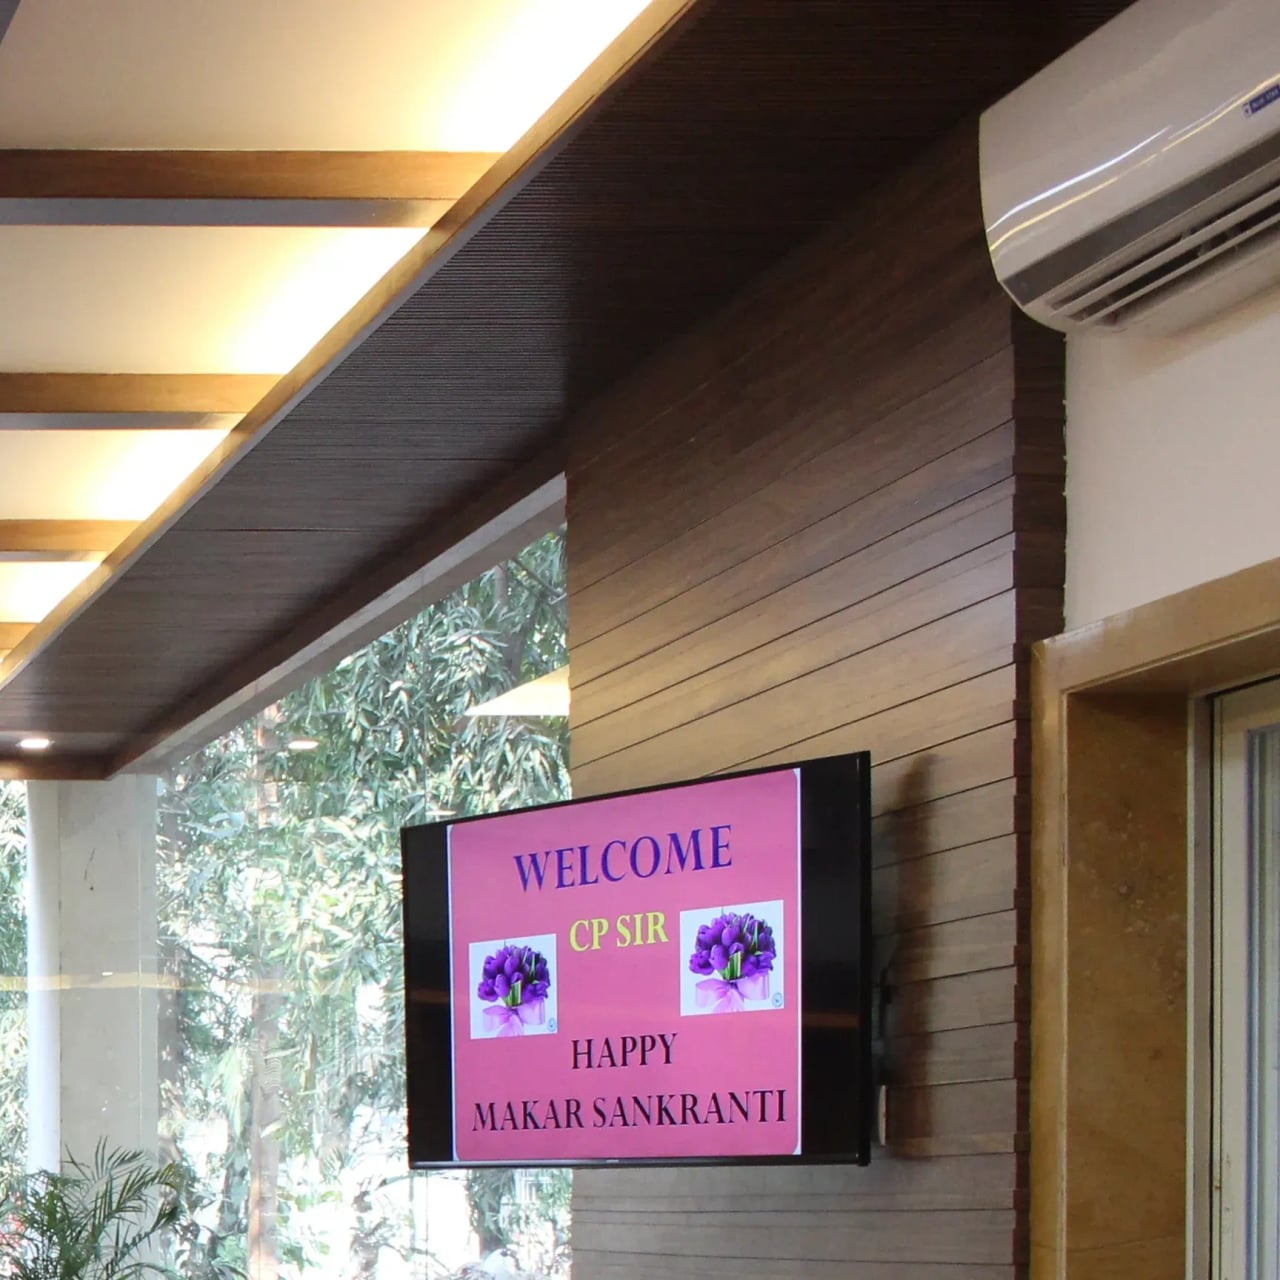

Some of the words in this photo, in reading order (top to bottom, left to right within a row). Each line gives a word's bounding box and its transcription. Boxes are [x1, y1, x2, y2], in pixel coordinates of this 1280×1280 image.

[513, 825, 732, 892] WELCOME
[570, 918, 608, 951] CP
[616, 911, 668, 947] SIR
[571, 1033, 678, 1070] HAPPY
[472, 1098, 584, 1131] MAKAR
[592, 1089, 786, 1128] SANKRANTI
